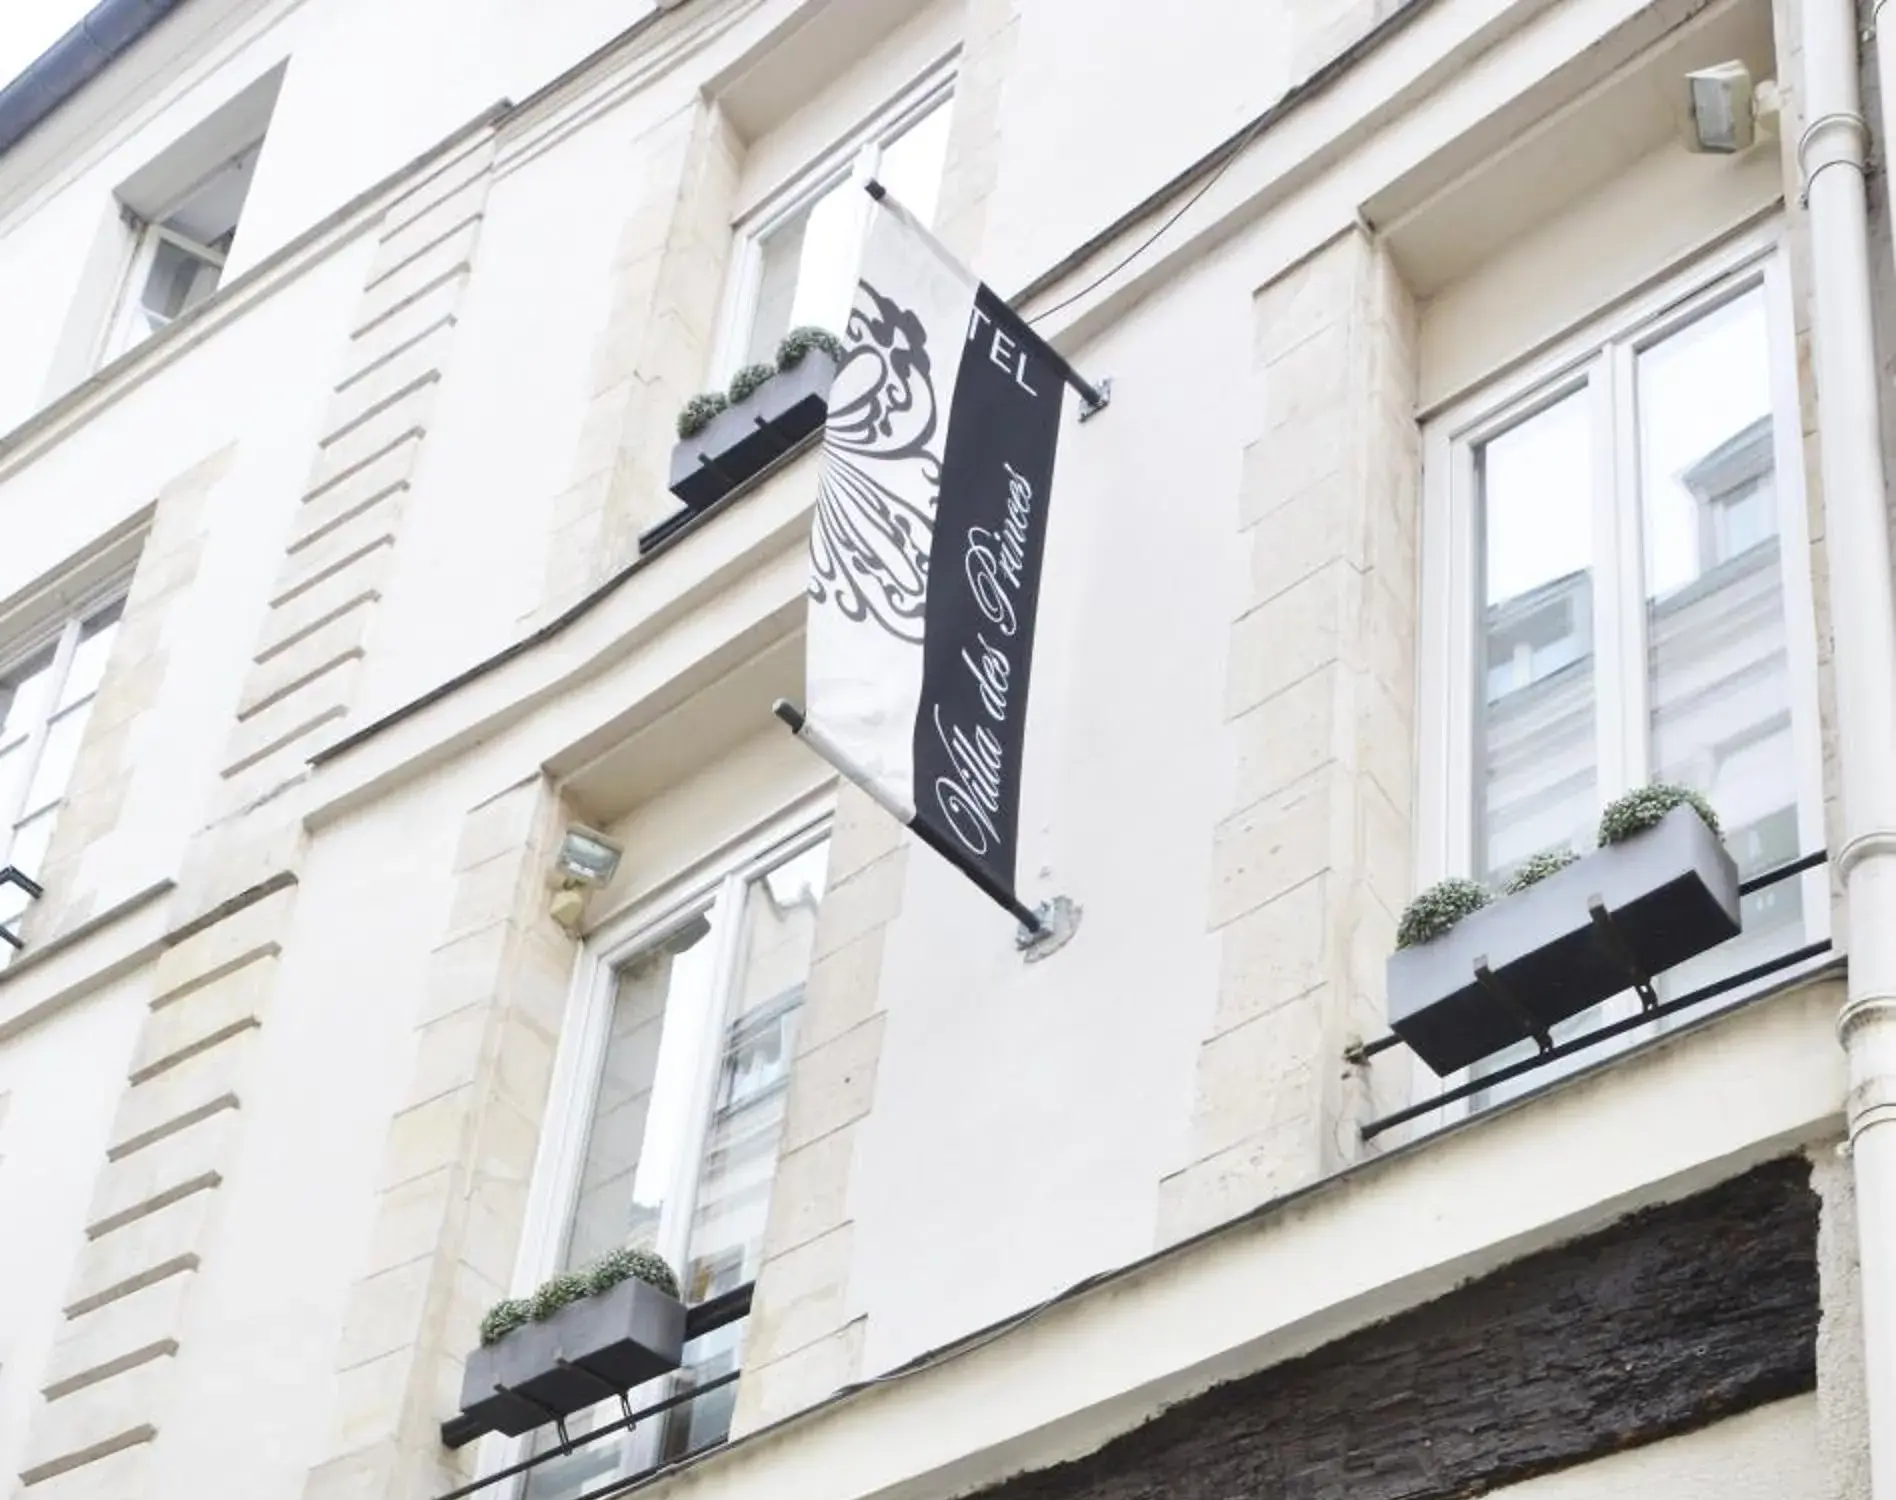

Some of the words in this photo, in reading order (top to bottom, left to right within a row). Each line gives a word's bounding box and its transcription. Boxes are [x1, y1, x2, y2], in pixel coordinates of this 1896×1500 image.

[965, 461, 1033, 636] Princes
[961, 632, 1011, 721] des
[934, 702, 1003, 855] Villa
